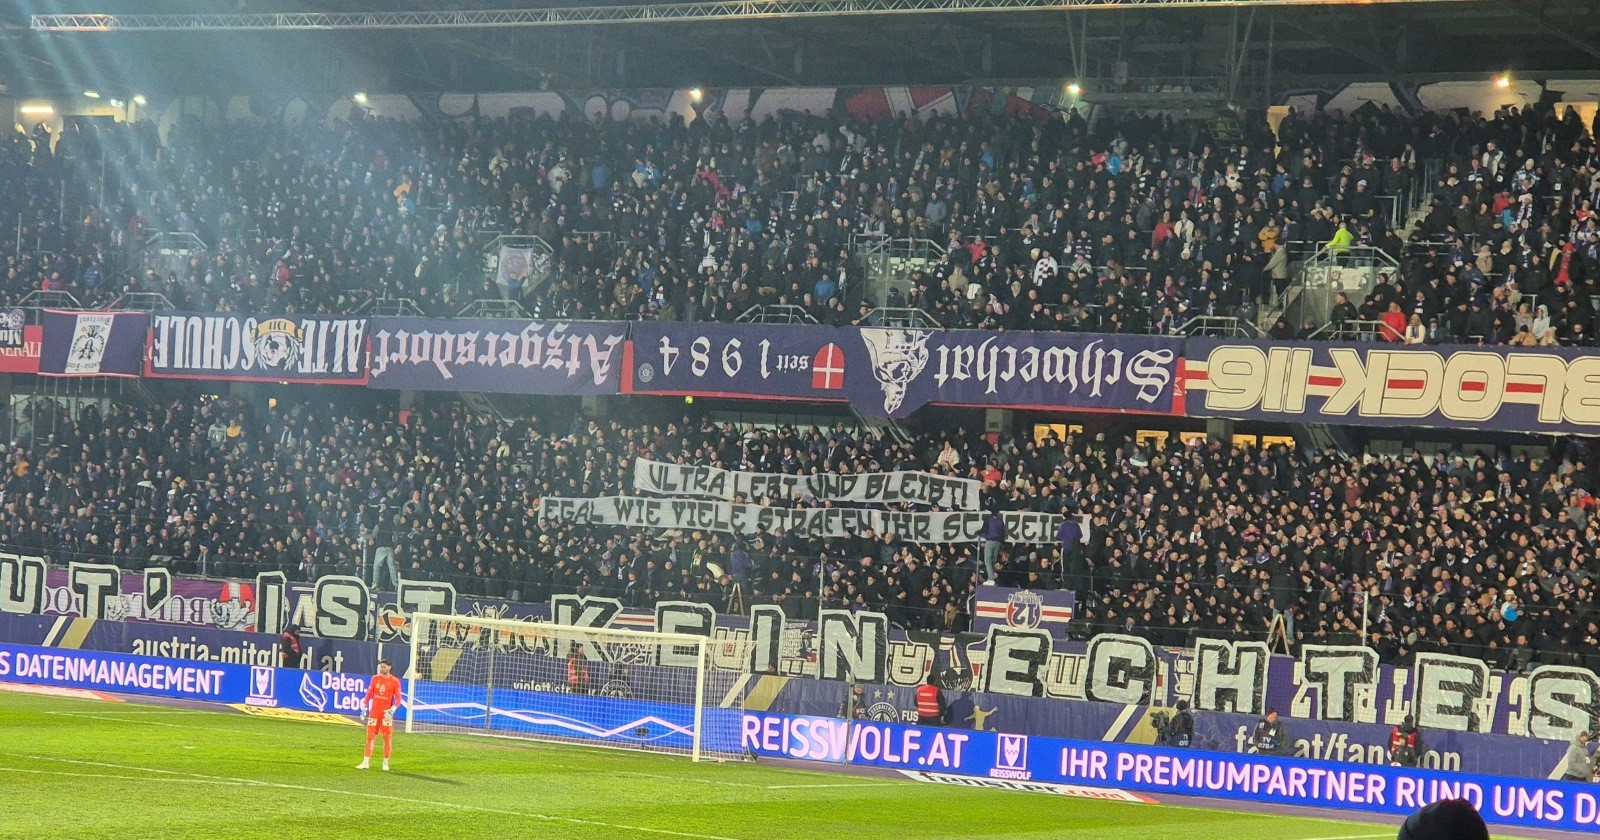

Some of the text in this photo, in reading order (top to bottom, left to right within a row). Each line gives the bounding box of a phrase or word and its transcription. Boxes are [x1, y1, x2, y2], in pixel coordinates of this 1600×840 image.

[153, 315, 367, 374] ALTE SCHULE
[369, 321, 626, 386] Atzgersdorf
[659, 335, 772, 380] 1984
[776, 354, 810, 373] seit
[933, 335, 1175, 403] Schwechat
[649, 460, 726, 495] ULTRA
[734, 473, 798, 500] LEBT
[806, 474, 859, 499] UND
[545, 499, 604, 523] EGAL
[613, 498, 661, 526] WIE
[672, 500, 748, 530] VIELE
[758, 507, 872, 535] STRAFEN
[881, 511, 931, 540] IHR
[1012, 602, 1039, 626] 12
[16, 652, 226, 695] DATENMANAGEMENT
[256, 570, 457, 644] IST
[551, 593, 889, 686] KEIN
[984, 622, 1600, 741] ECHTES
[322, 671, 368, 693] Daten.
[742, 714, 969, 768] REISSWOLF.AT
[990, 768, 1032, 780] REISSWOLF
[1061, 747, 1109, 779] IHR
[1117, 752, 1386, 805] PREMIUMPARTNER
[1494, 785, 1564, 822] UMS
